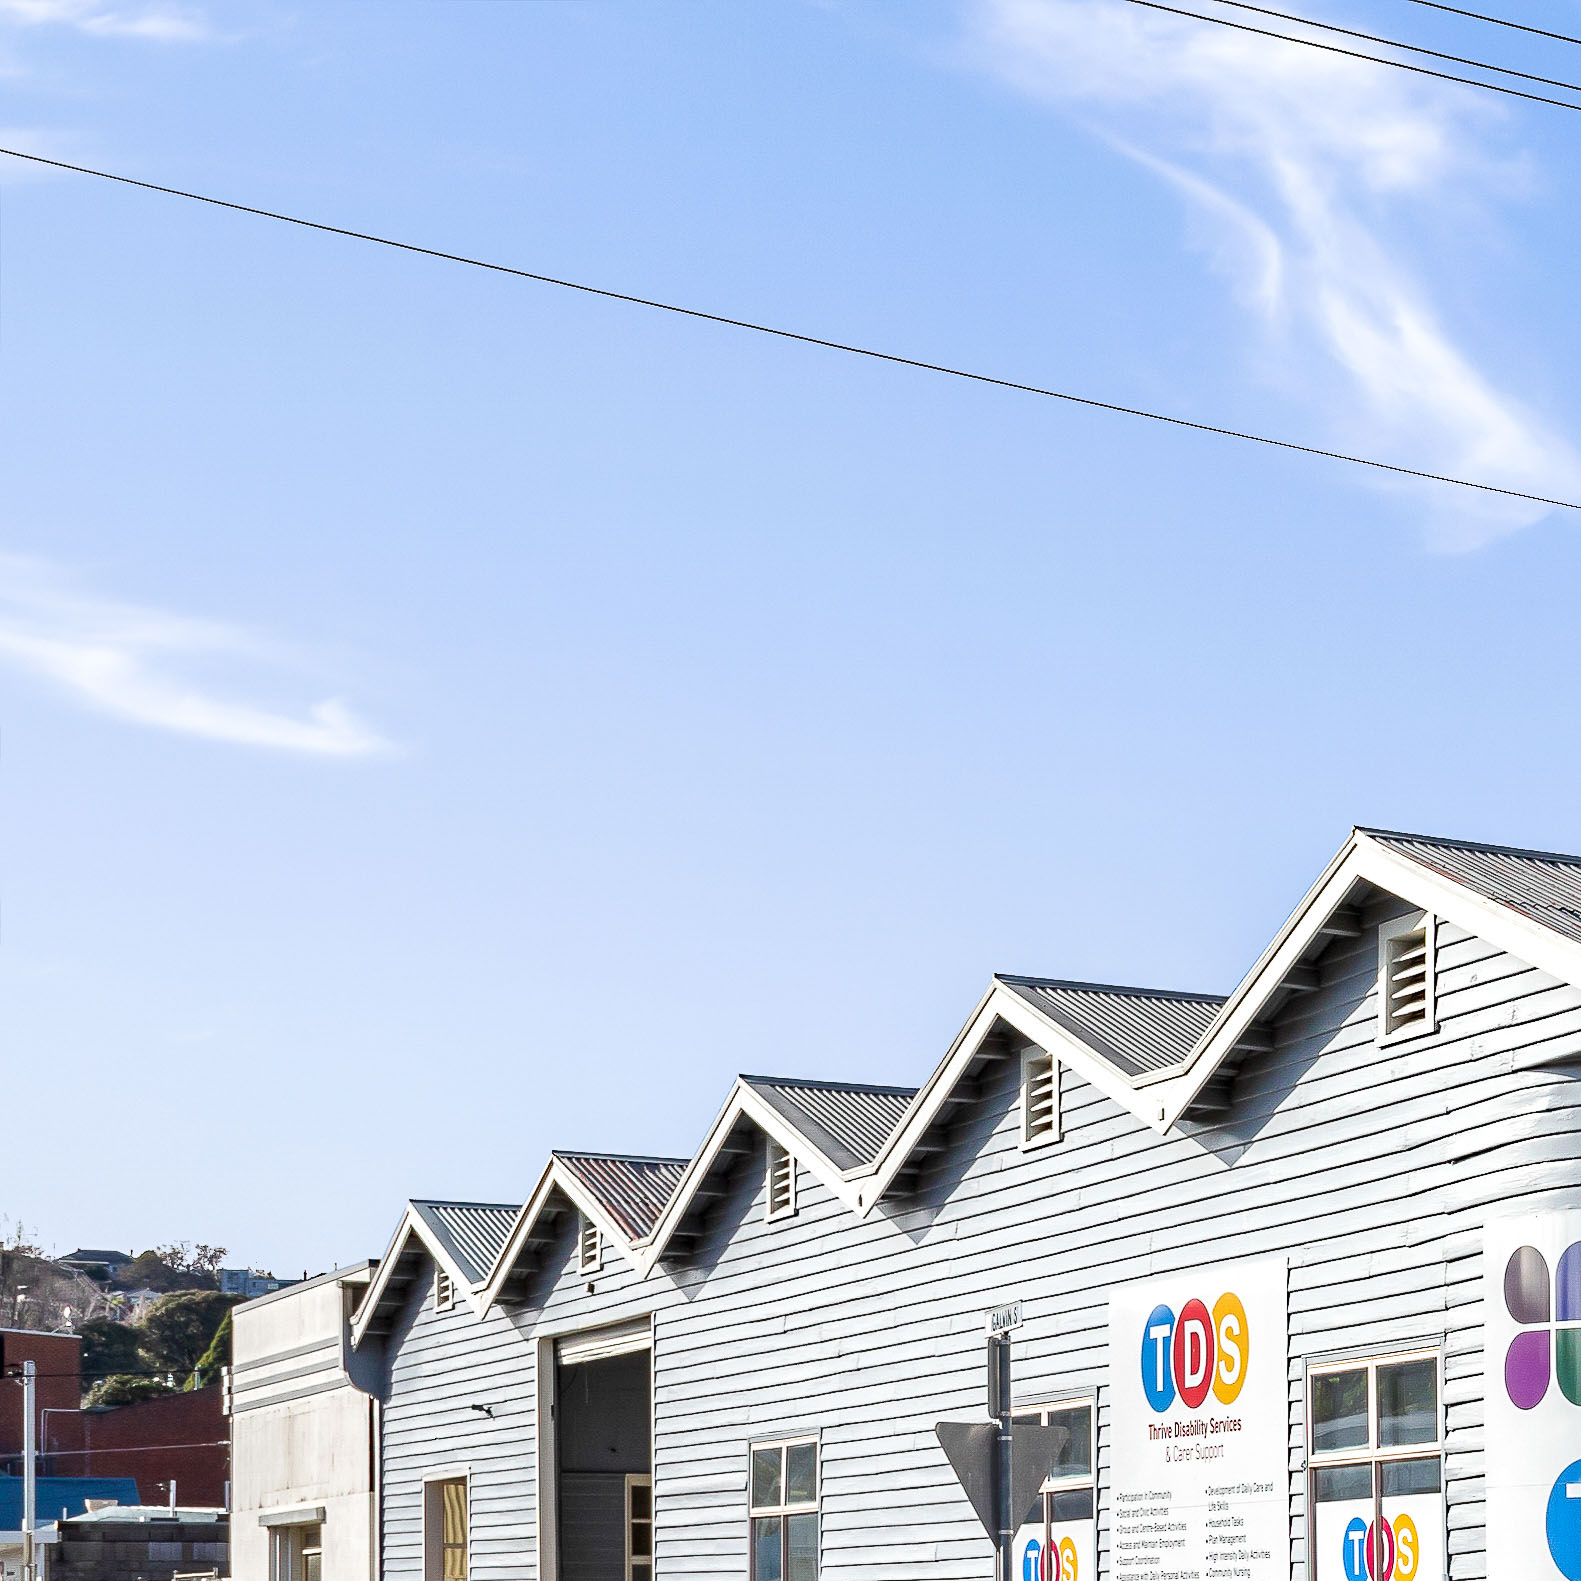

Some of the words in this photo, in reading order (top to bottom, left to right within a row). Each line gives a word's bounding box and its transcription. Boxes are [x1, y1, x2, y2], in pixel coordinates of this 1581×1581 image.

[1149, 1313, 1241, 1392] TDS
[1148, 1423, 1172, 1440] Thrive
[1174, 1419, 1208, 1438] Disability
[1209, 1416, 1242, 1434] Services
[1165, 1446, 1171, 1462] &
[1173, 1445, 1194, 1461] Carer
[1196, 1443, 1224, 1463] Support
